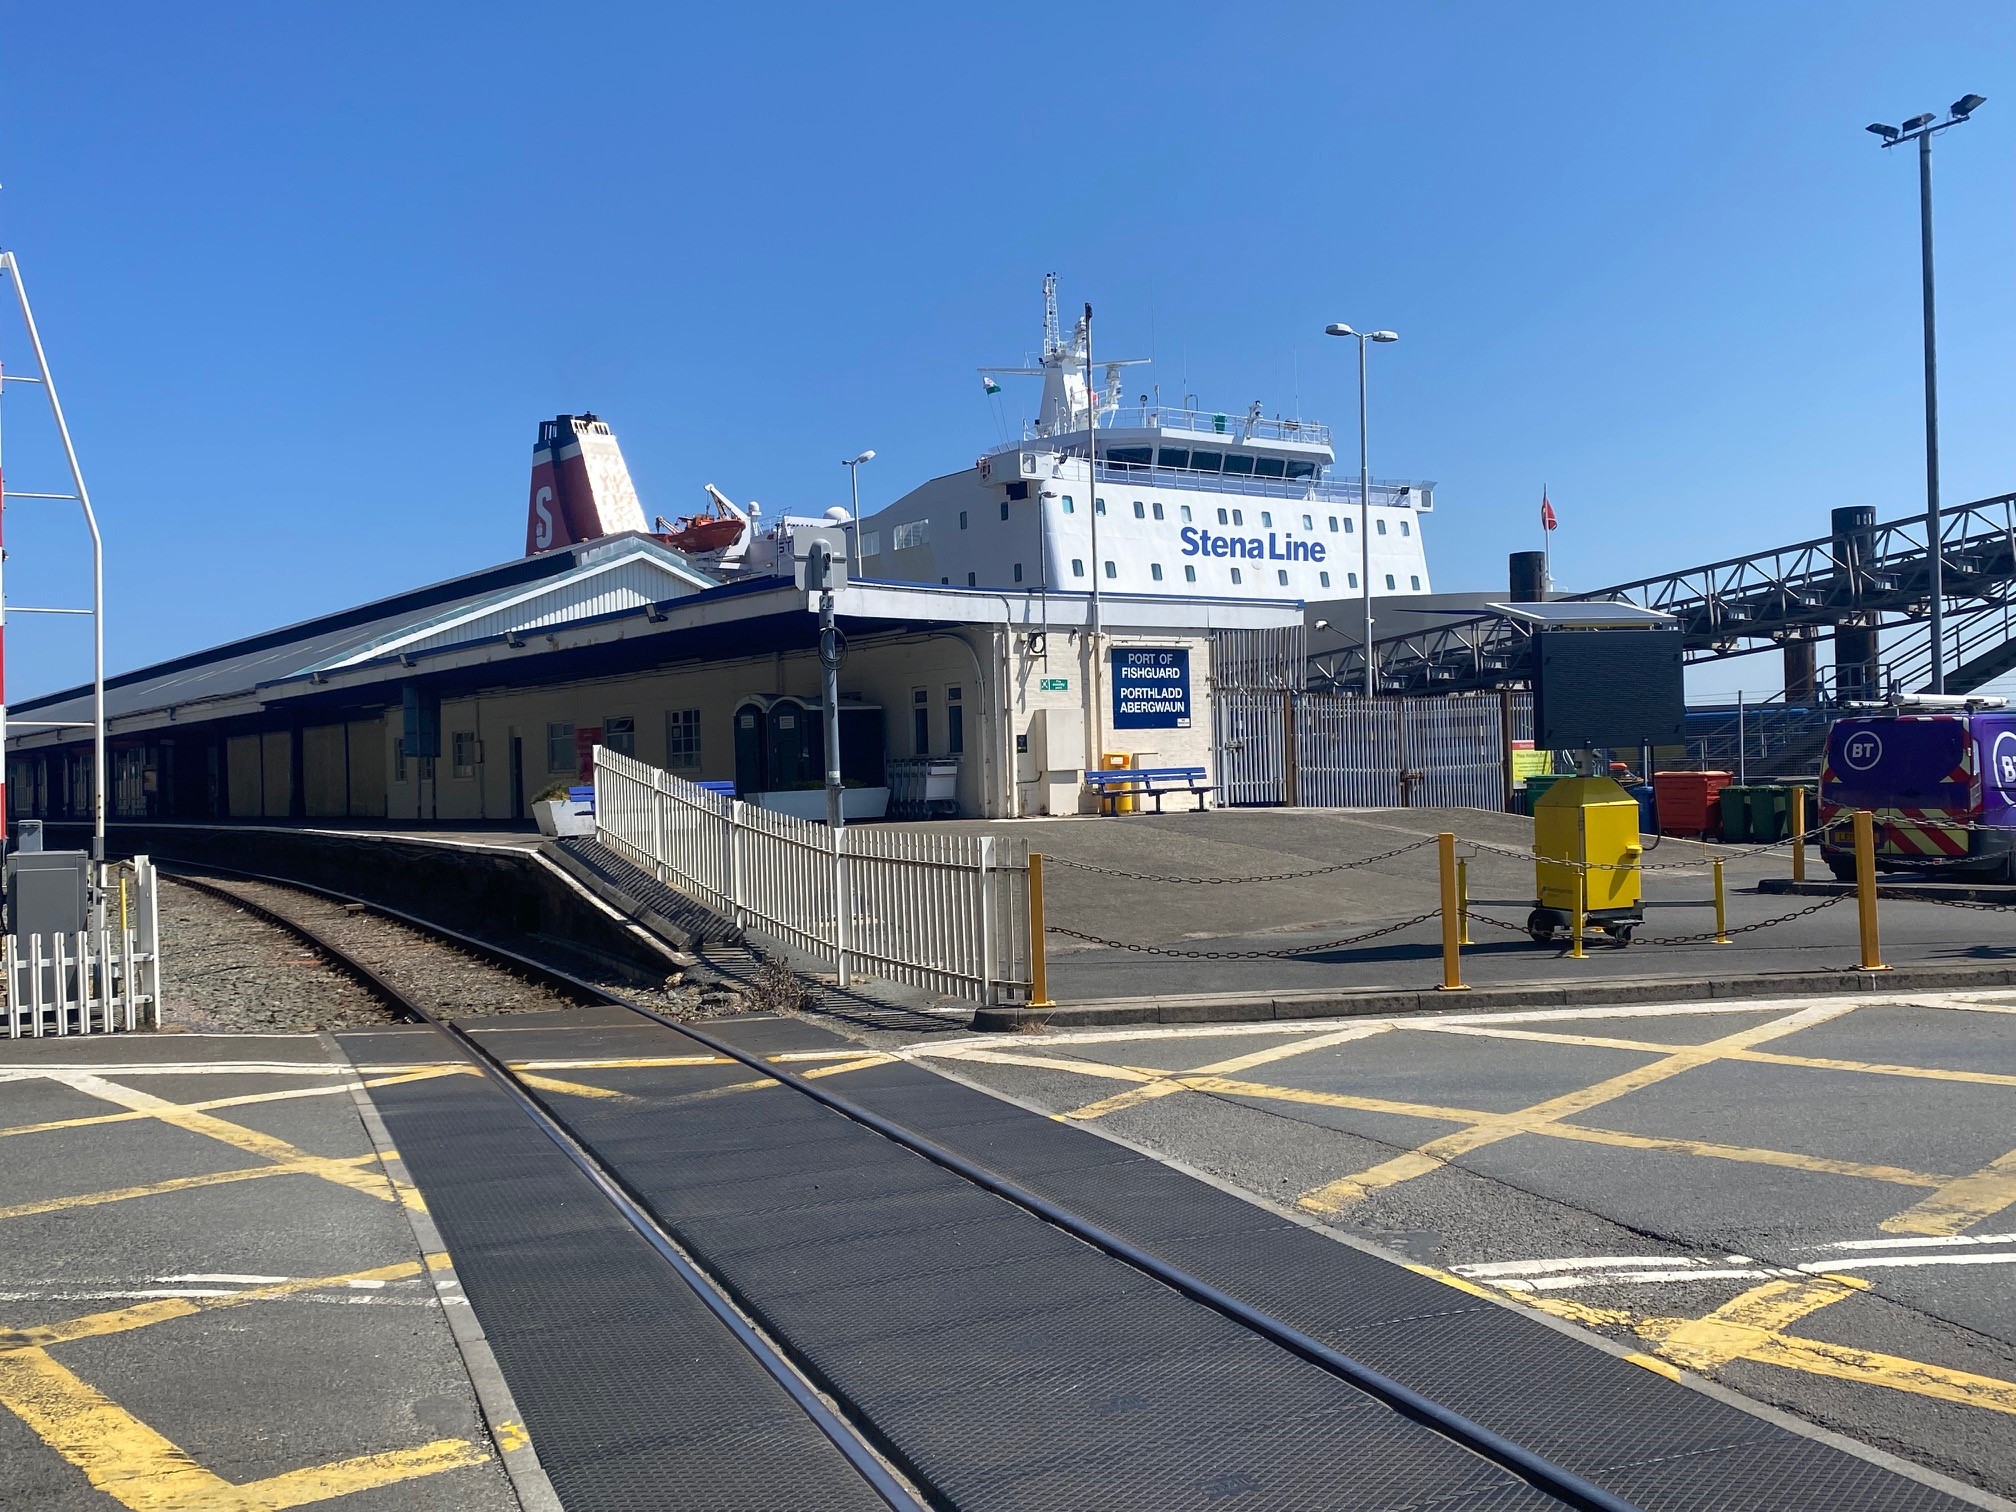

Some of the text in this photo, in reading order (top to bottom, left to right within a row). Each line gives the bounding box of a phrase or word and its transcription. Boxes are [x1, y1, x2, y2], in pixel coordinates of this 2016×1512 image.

[538, 487, 551, 548] S
[1180, 526, 1326, 562] Stena Line
[1128, 653, 1173, 664] PORT OF
[1121, 667, 1180, 679] FISHGUARD
[1120, 688, 1183, 699] PORTHLADD
[1120, 702, 1185, 713] ABERGWAUN
[1852, 743, 1874, 758] BT
